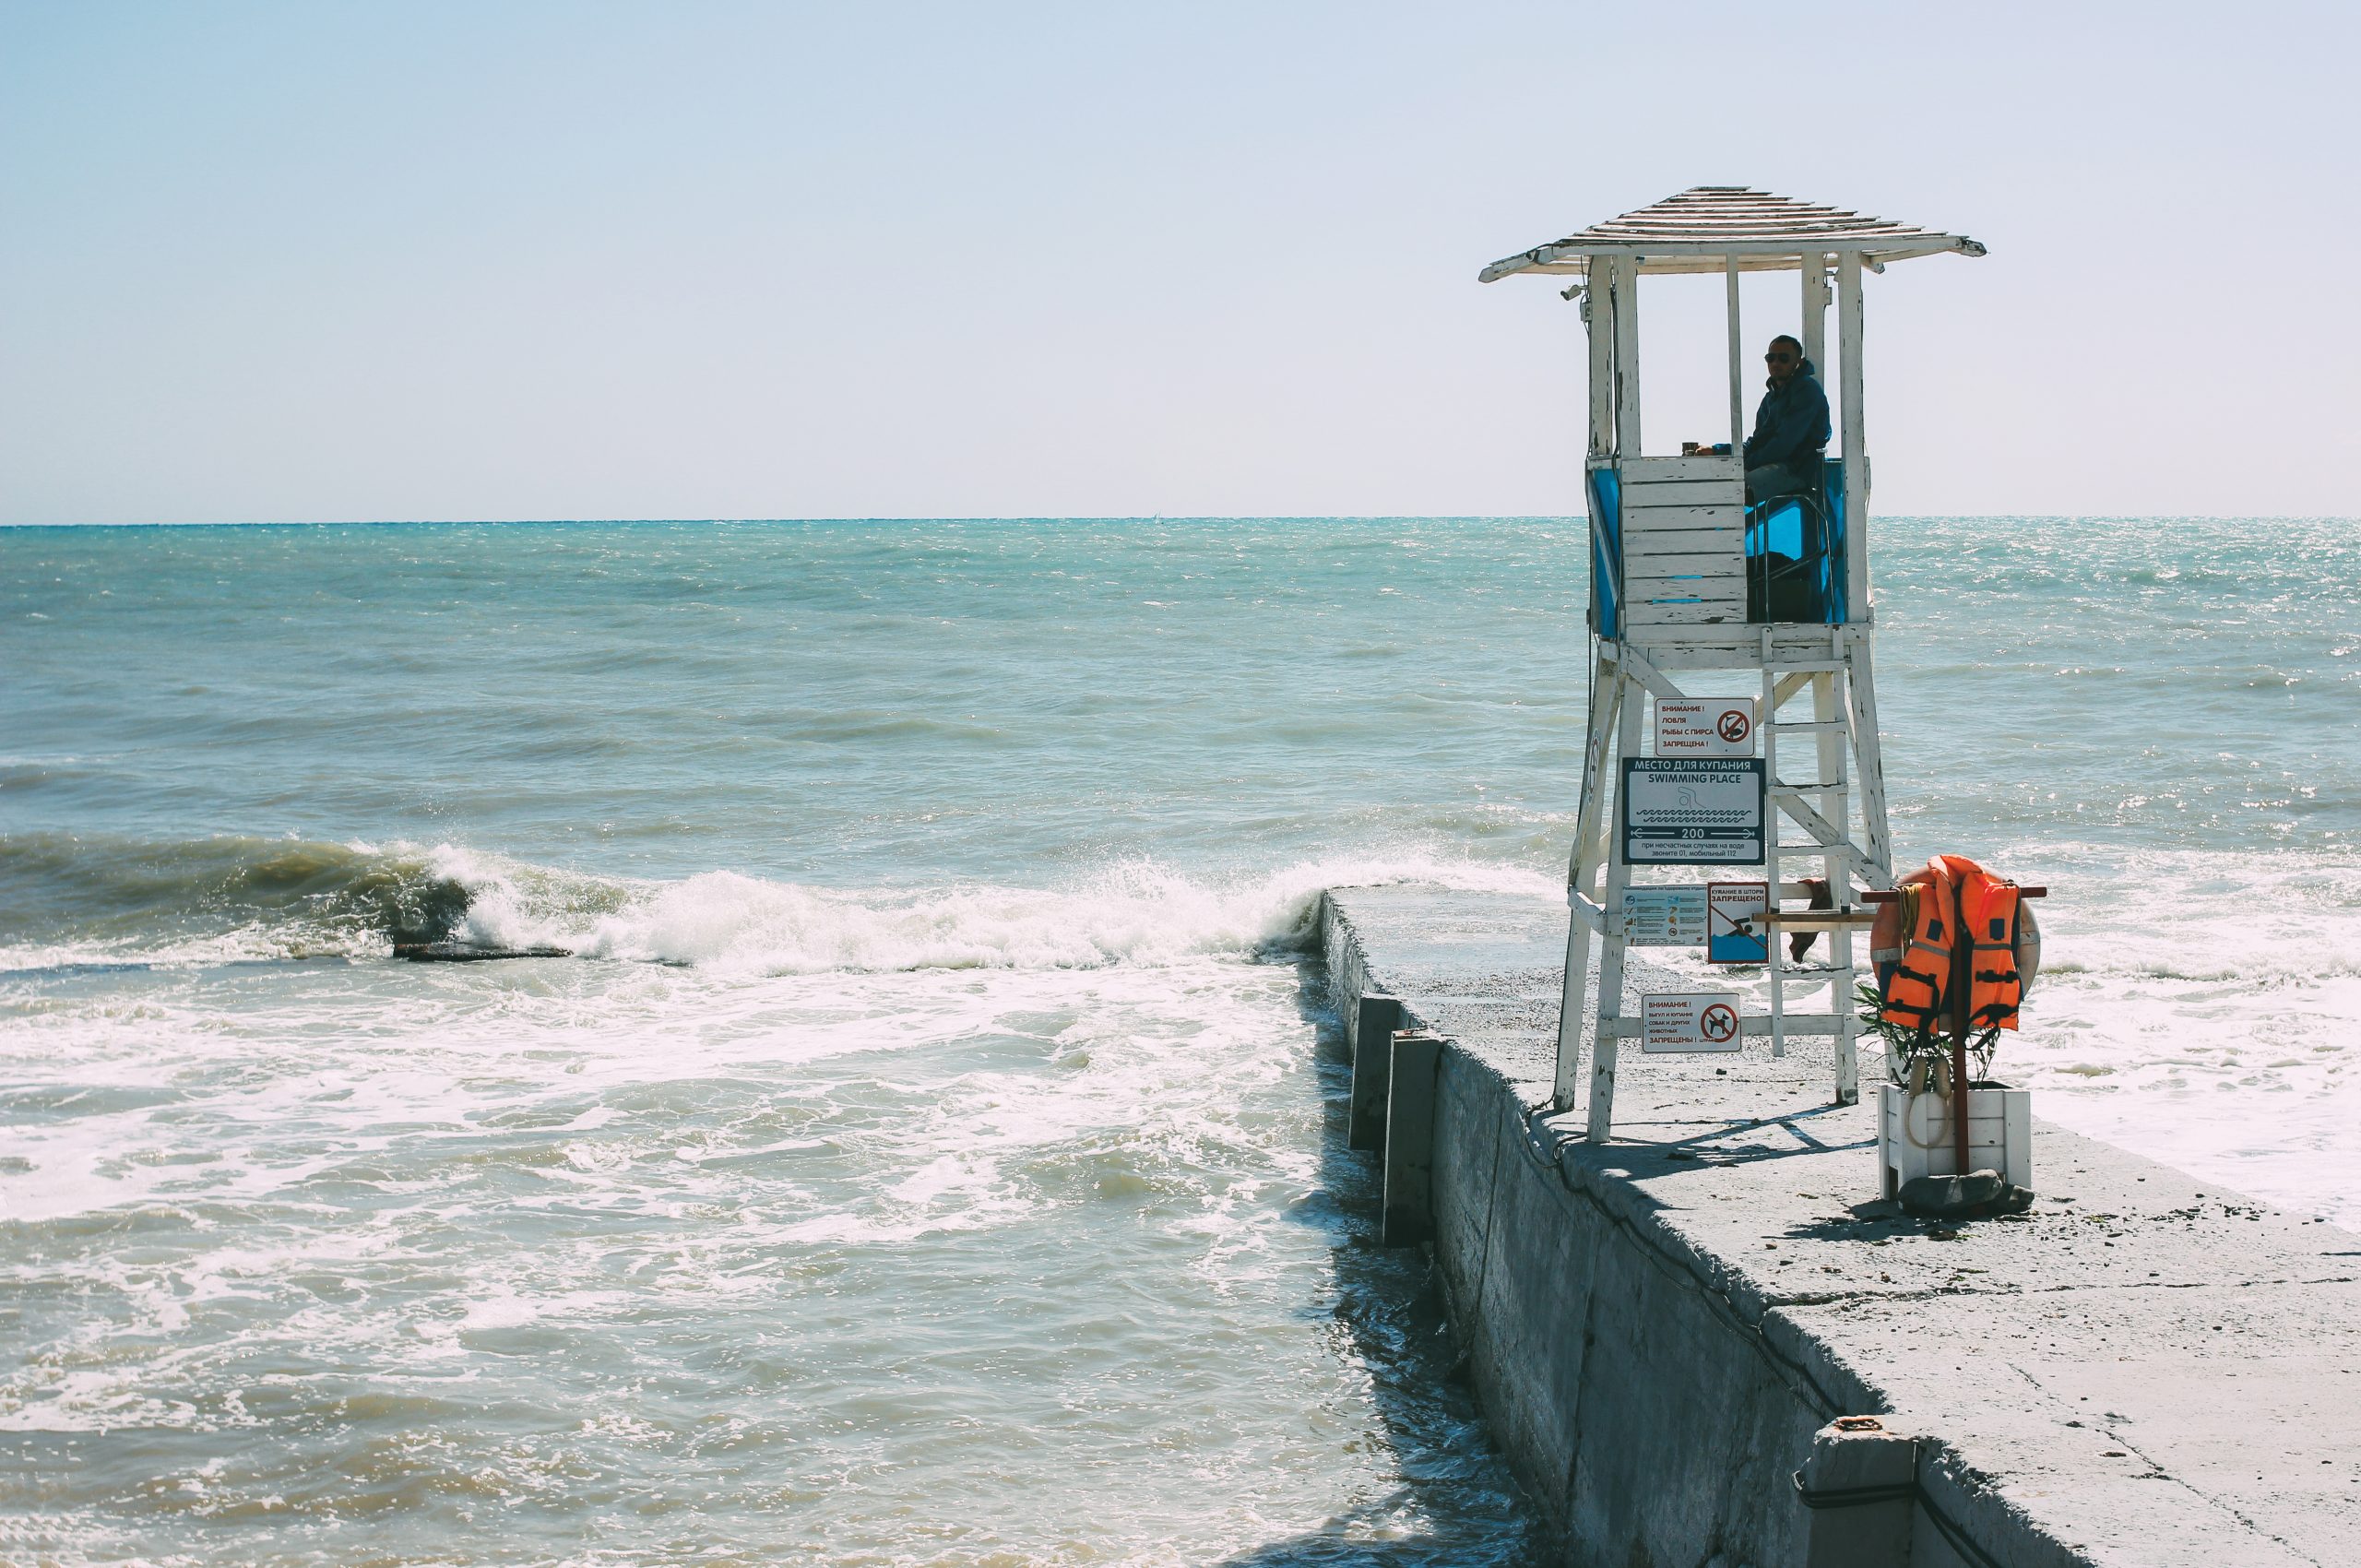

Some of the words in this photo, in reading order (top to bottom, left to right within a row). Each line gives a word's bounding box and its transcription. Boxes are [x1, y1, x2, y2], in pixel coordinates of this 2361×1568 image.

[1635, 760, 1671, 770] МЕСТО
[1673, 761, 1697, 771] ДЛЯ
[1700, 761, 1751, 770] КУПАНИЯ
[1648, 773, 1707, 783] SWIMMING
[1709, 774, 1741, 784] PLACE
[1682, 829, 1704, 838] 200
